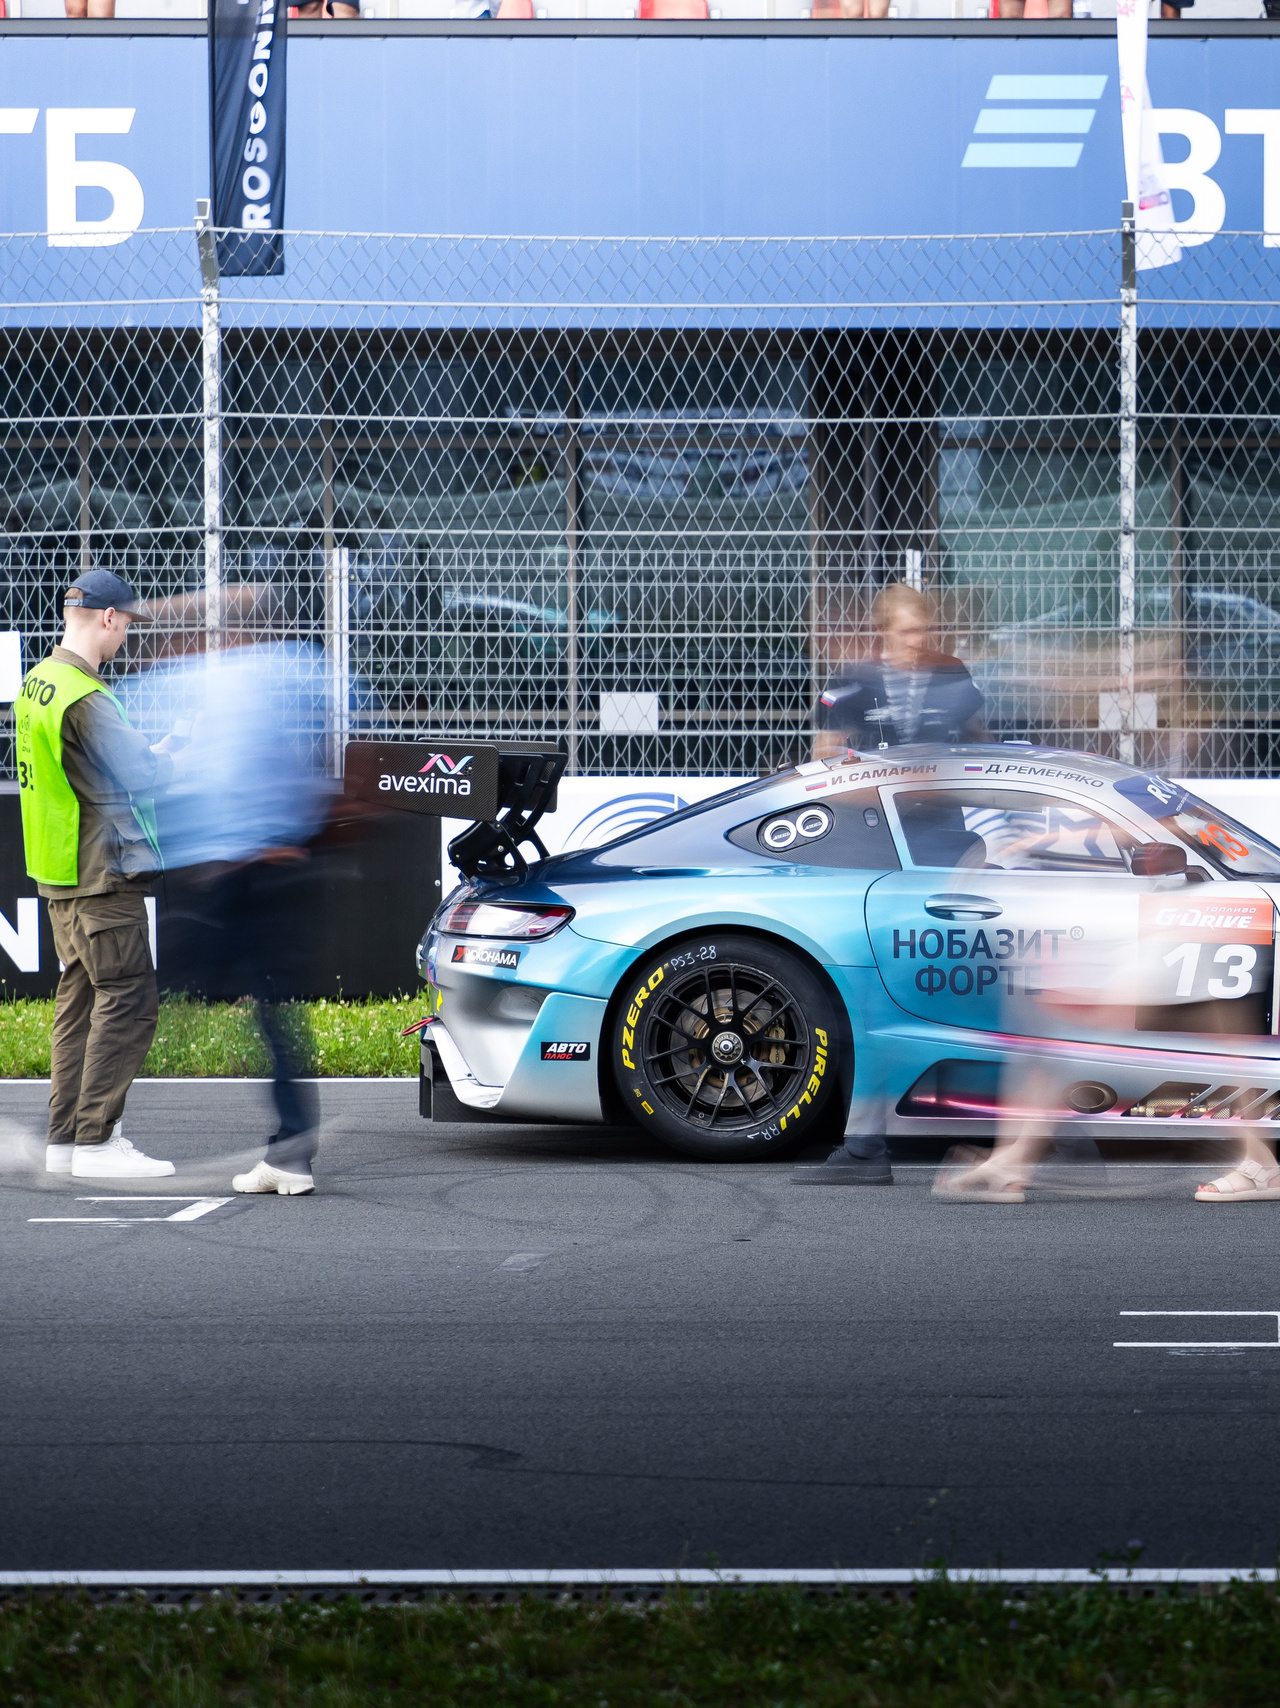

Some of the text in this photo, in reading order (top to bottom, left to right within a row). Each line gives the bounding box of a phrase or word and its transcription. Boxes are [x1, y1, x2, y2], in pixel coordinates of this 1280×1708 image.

[378, 772, 472, 796] avexima
[1197, 824, 1250, 862] 13
[466, 948, 518, 967] YOKOHAMA
[1162, 942, 1257, 1000] 13
[914, 964, 1043, 997] ФОРТЕ
[543, 1052, 573, 1060] ПЛЮС
[546, 1042, 588, 1054] АВТО
[779, 1027, 828, 1131] PIRELLI
